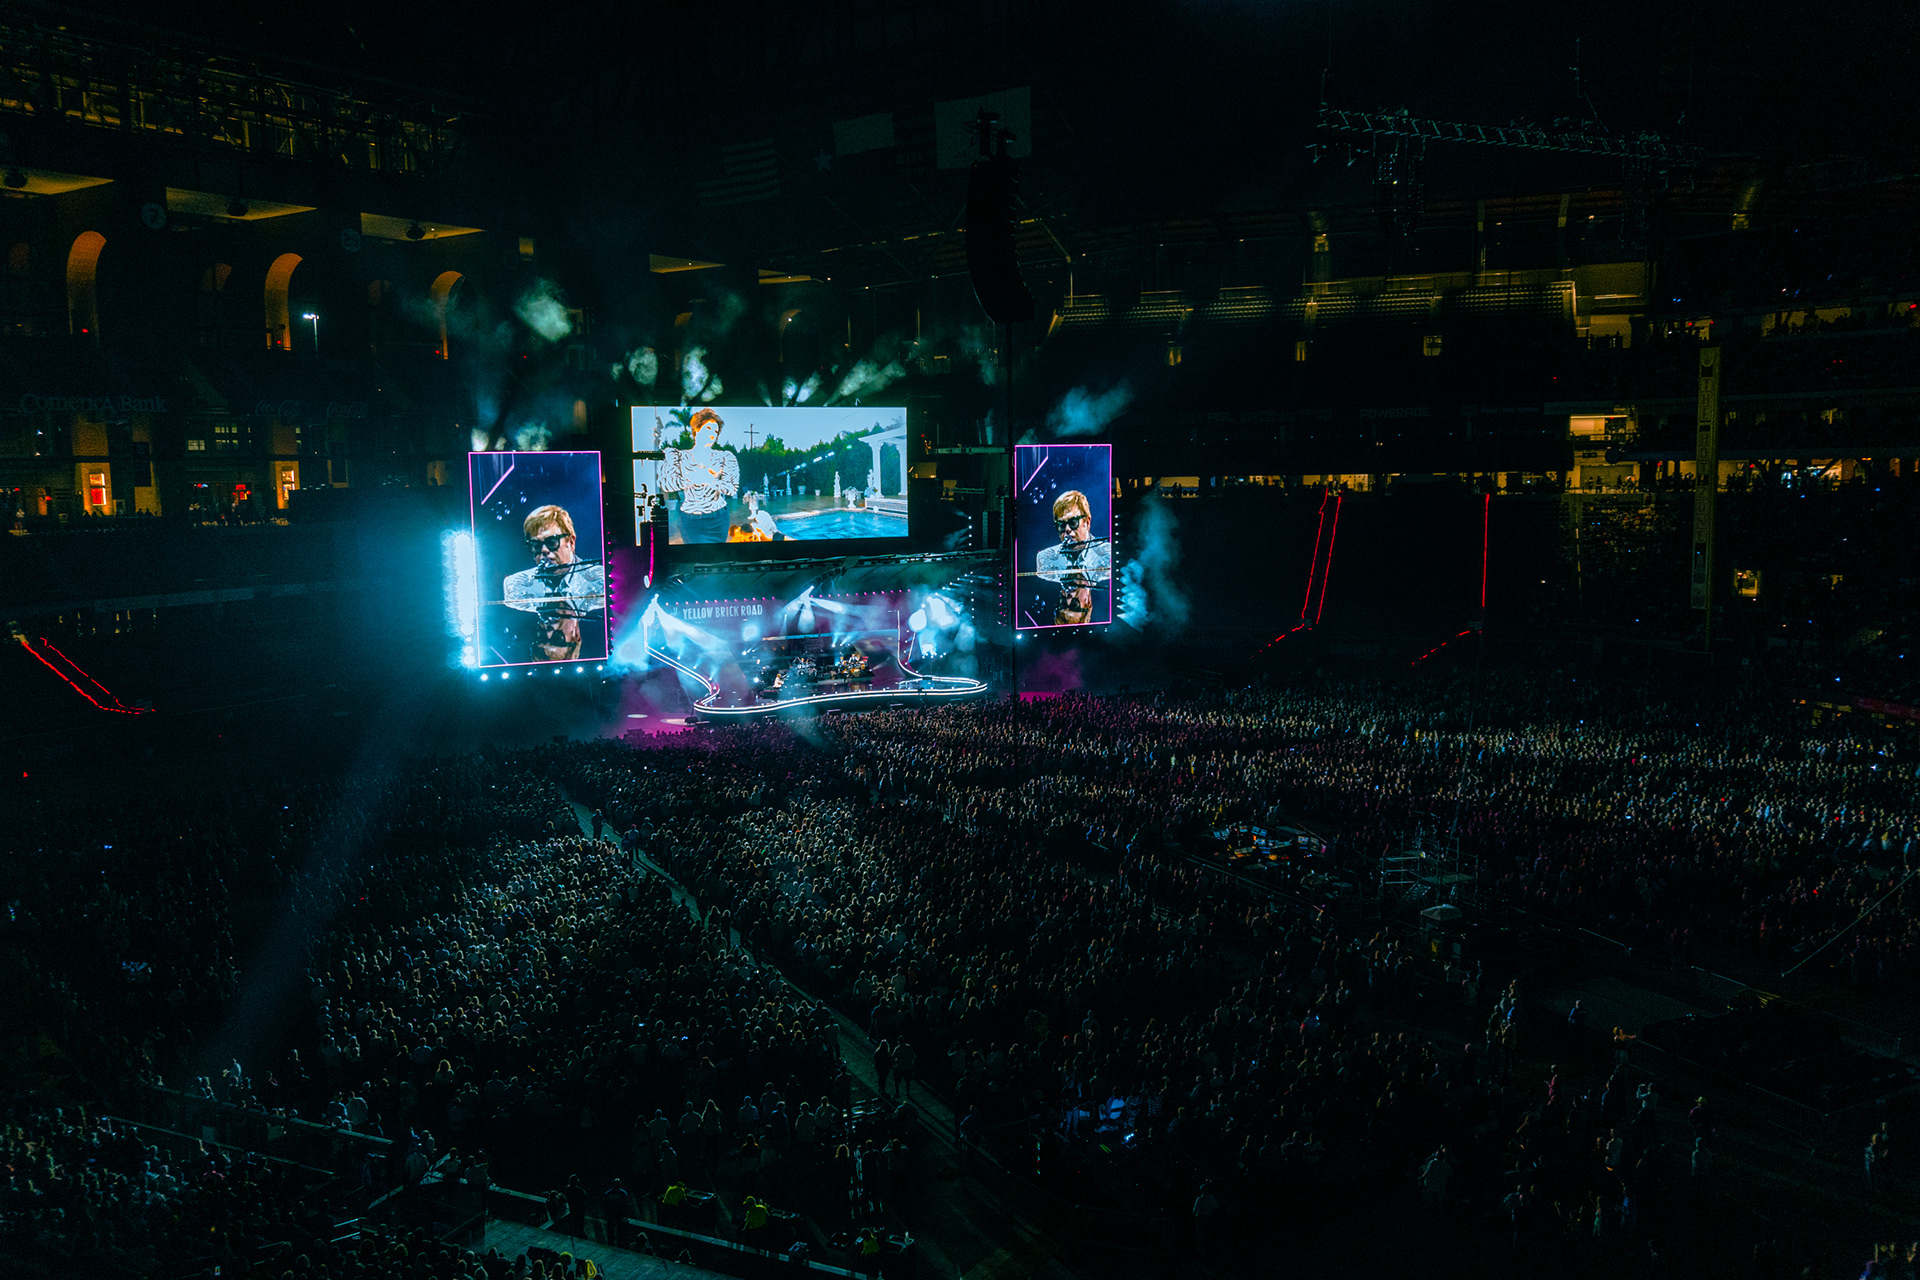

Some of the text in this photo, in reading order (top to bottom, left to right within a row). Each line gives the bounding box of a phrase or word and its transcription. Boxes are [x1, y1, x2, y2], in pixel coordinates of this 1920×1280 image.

[119, 395, 169, 414] Bank
[1359, 406, 1431, 419] POWERADE
[682, 606, 714, 620] YELLOW
[715, 605, 739, 619] BRICK
[740, 604, 763, 617] ROAD
